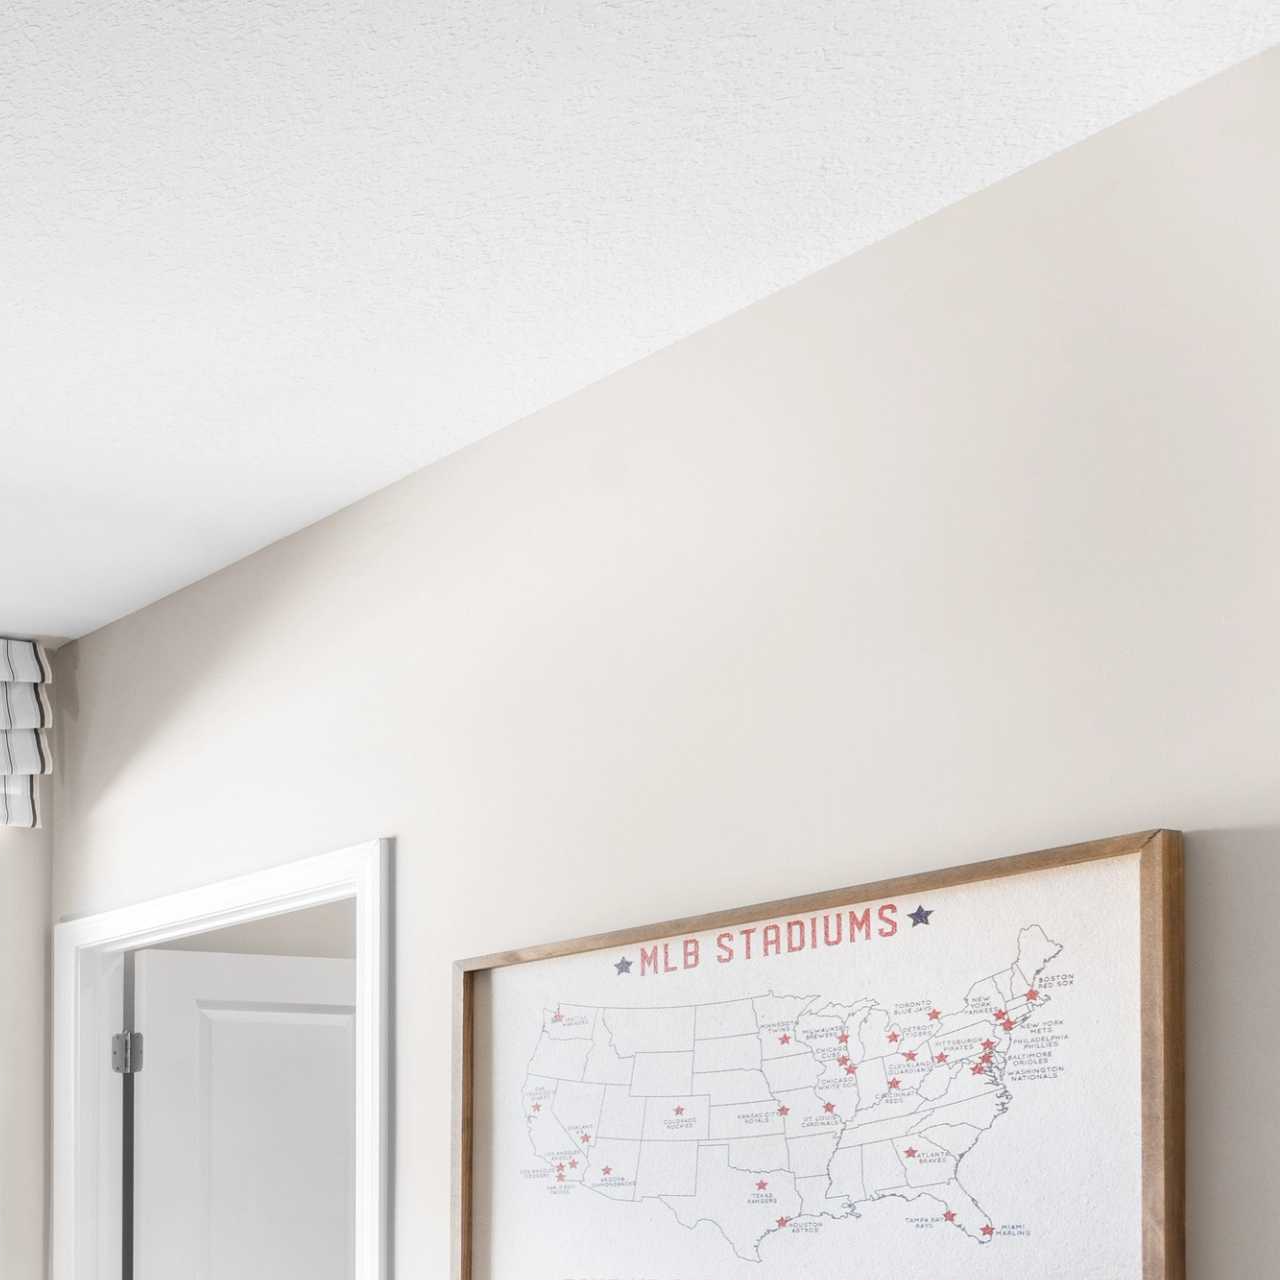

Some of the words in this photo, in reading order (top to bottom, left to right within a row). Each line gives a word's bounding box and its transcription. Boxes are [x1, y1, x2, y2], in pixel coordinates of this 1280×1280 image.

[640, 938, 700, 976] MLB
[716, 903, 898, 964] STADIUMS
[1038, 973, 1075, 984] BOSTON
[894, 999, 933, 1009] TORONTO
[1013, 1034, 1069, 1044] PHILADELPHIA
[1007, 1051, 1053, 1061] BALTIMORE
[1007, 1066, 1065, 1076] WASHINGTON
[1011, 1073, 1058, 1081] NATIONALS
